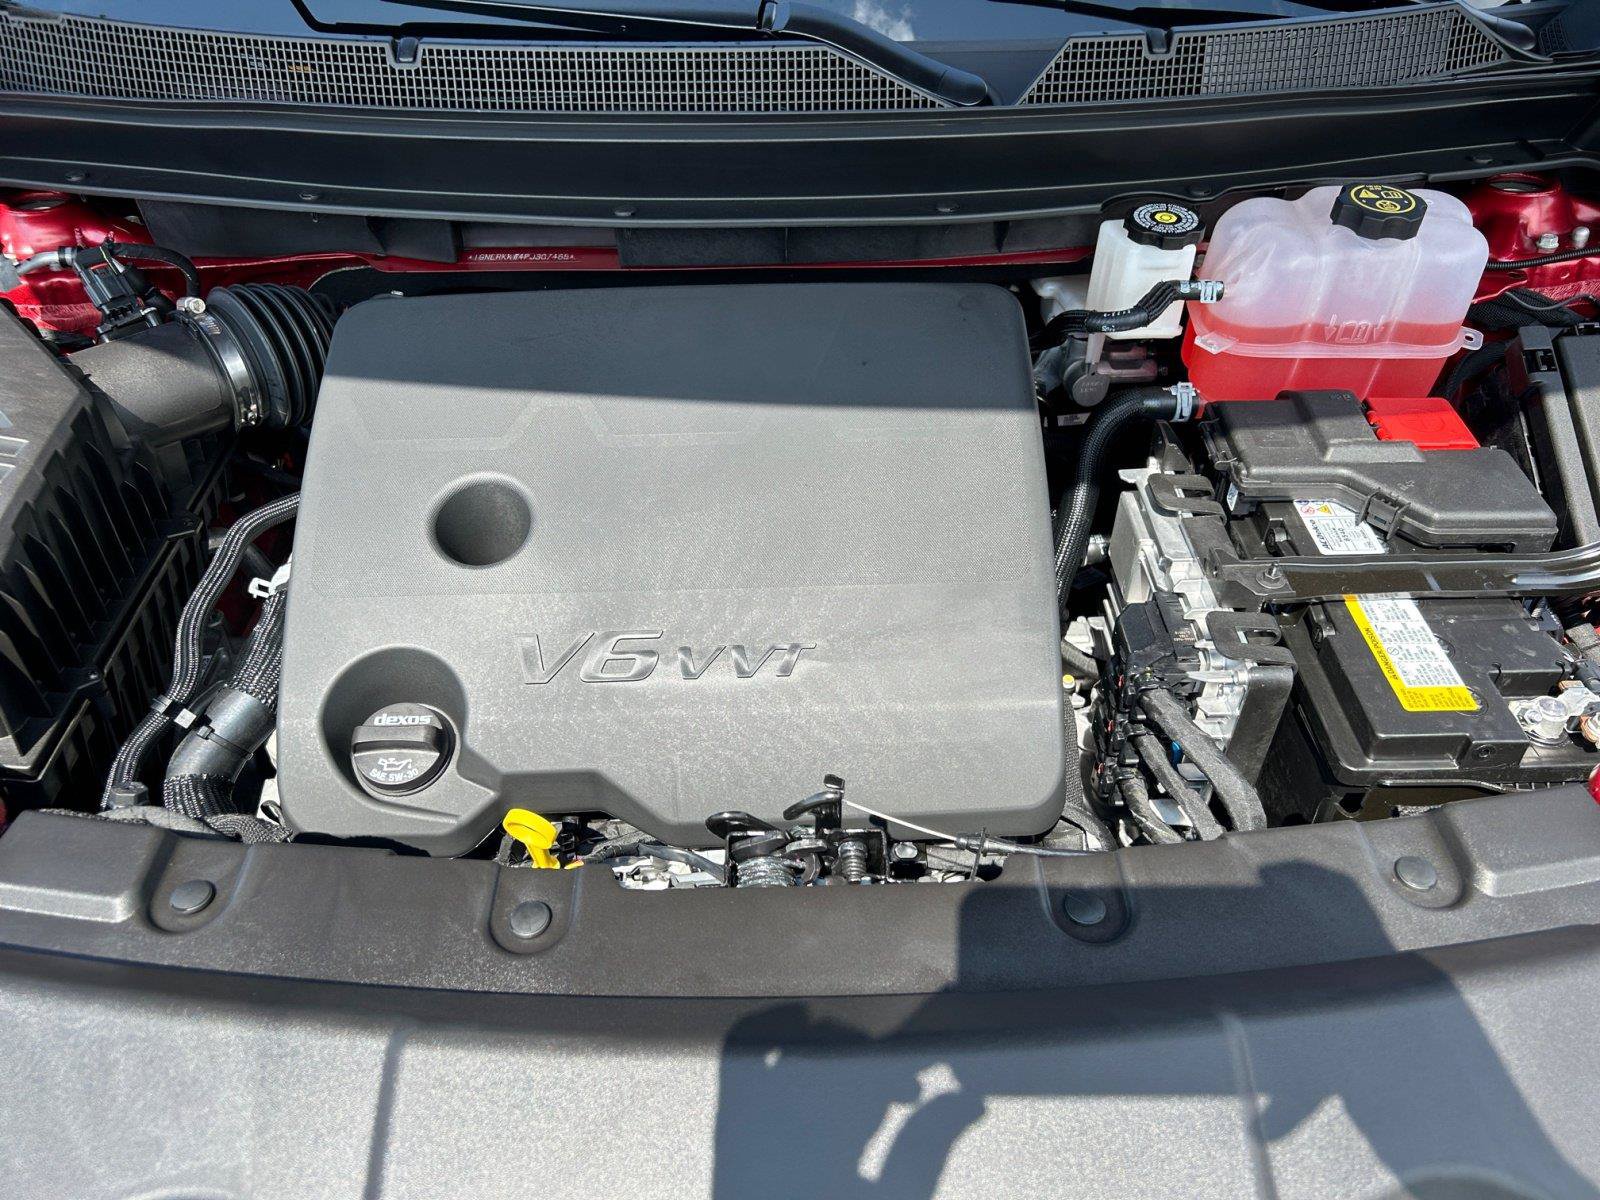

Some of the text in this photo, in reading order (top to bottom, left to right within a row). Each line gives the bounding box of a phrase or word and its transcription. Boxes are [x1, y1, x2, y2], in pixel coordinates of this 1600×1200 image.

[517, 630, 817, 684] V6 VVT
[1364, 627, 1394, 674] DANGER POISON
[373, 713, 433, 726] dexos
[369, 768, 419, 782] SAE 5W-30
